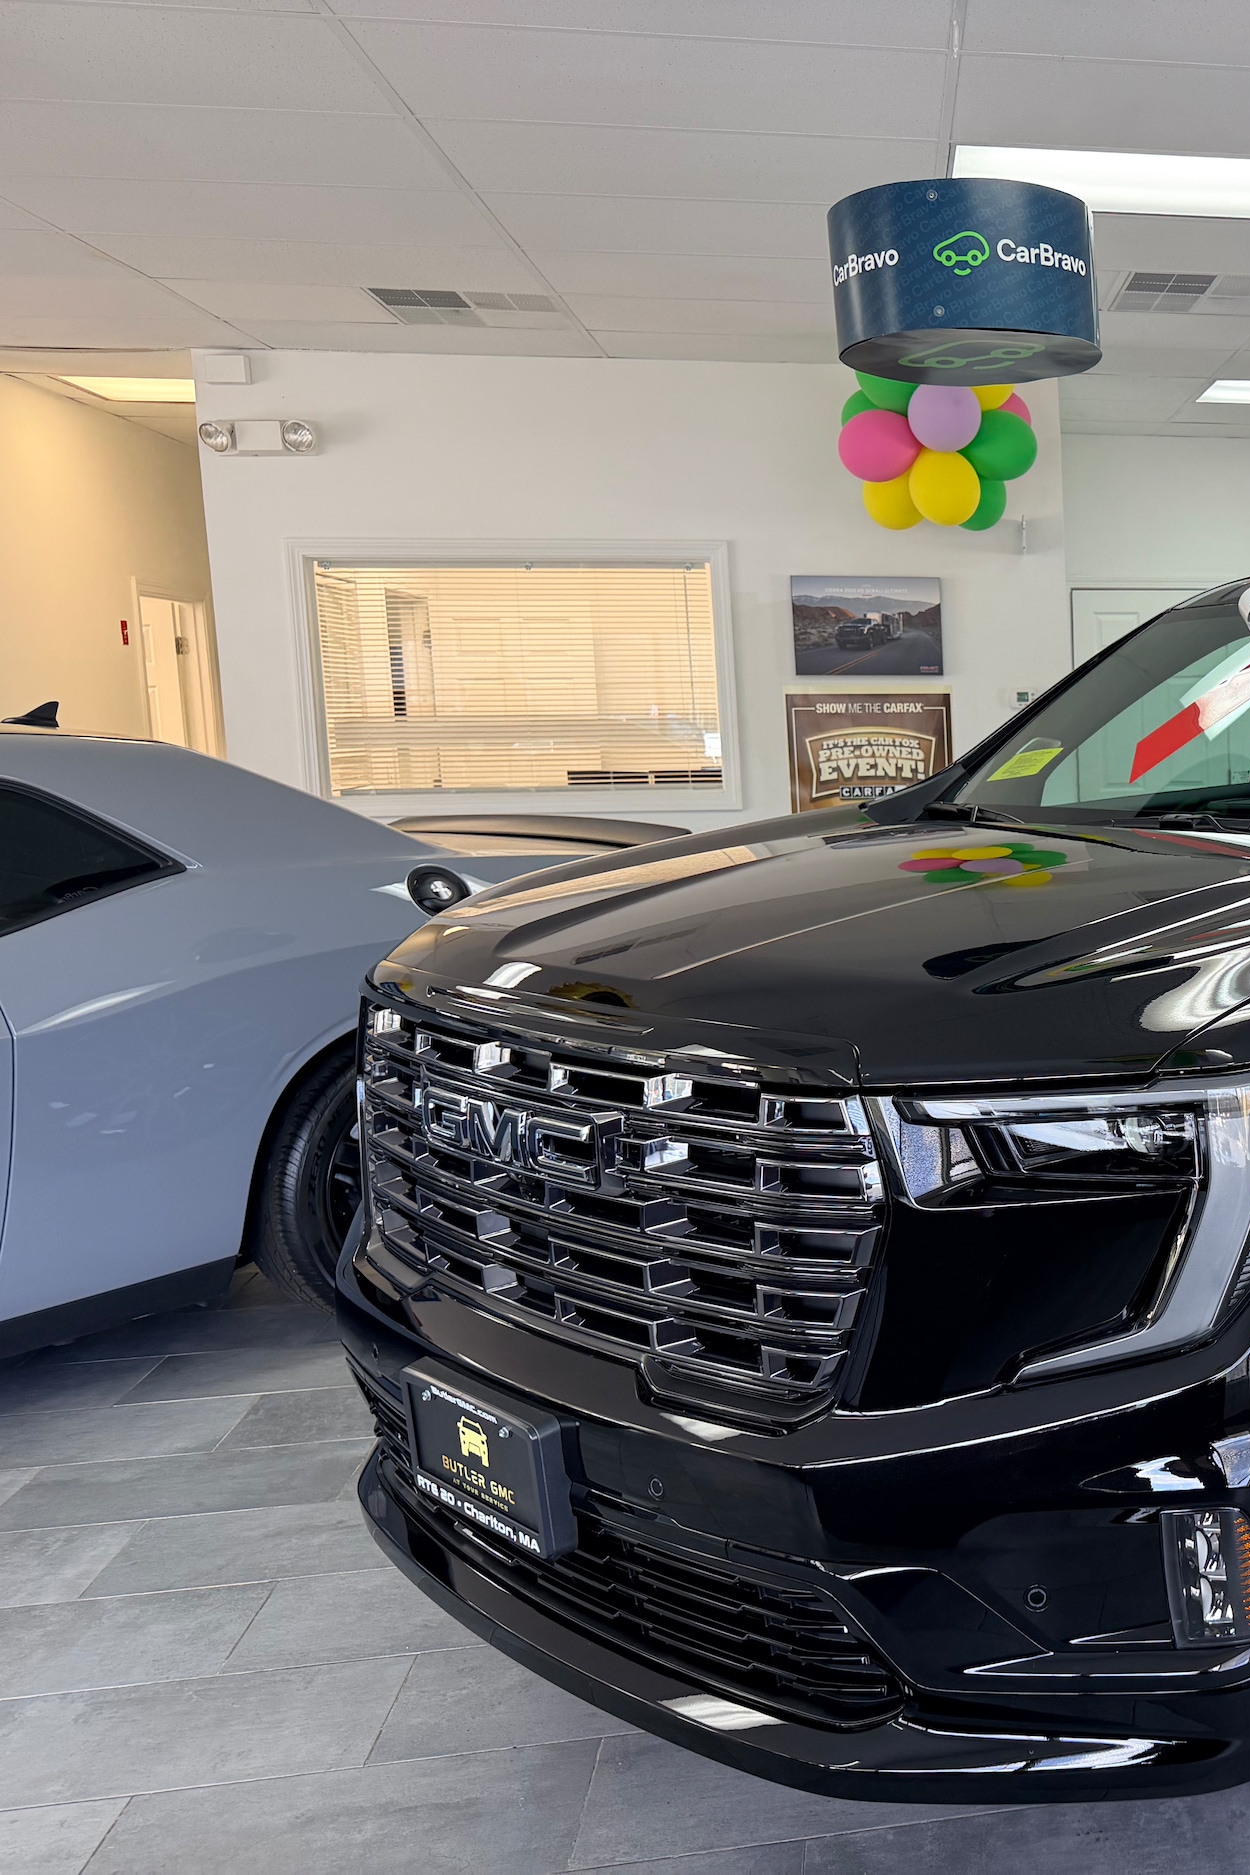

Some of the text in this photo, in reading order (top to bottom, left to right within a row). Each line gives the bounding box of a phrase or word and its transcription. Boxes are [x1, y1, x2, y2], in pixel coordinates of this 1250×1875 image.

[833, 248, 899, 287] CarBravo
[996, 238, 1087, 276] CarBravo
[816, 703, 923, 714] SHOW ME THE CARFAX
[818, 746, 925, 762] PRE-OWNED
[823, 737, 920, 749] IT'S THE CAR FOX
[819, 758, 926, 782] EVENT!
[842, 786, 900, 798] CARFA
[422, 1086, 597, 1187] GMC
[442, 1454, 516, 1505] BUTLER GMC
[462, 1482, 479, 1496] YOUR
[480, 1492, 509, 1512] SERVICE
[440, 1487, 455, 1506] 20
[463, 1501, 517, 1542] Charlton,
[518, 1531, 541, 1554] MA
